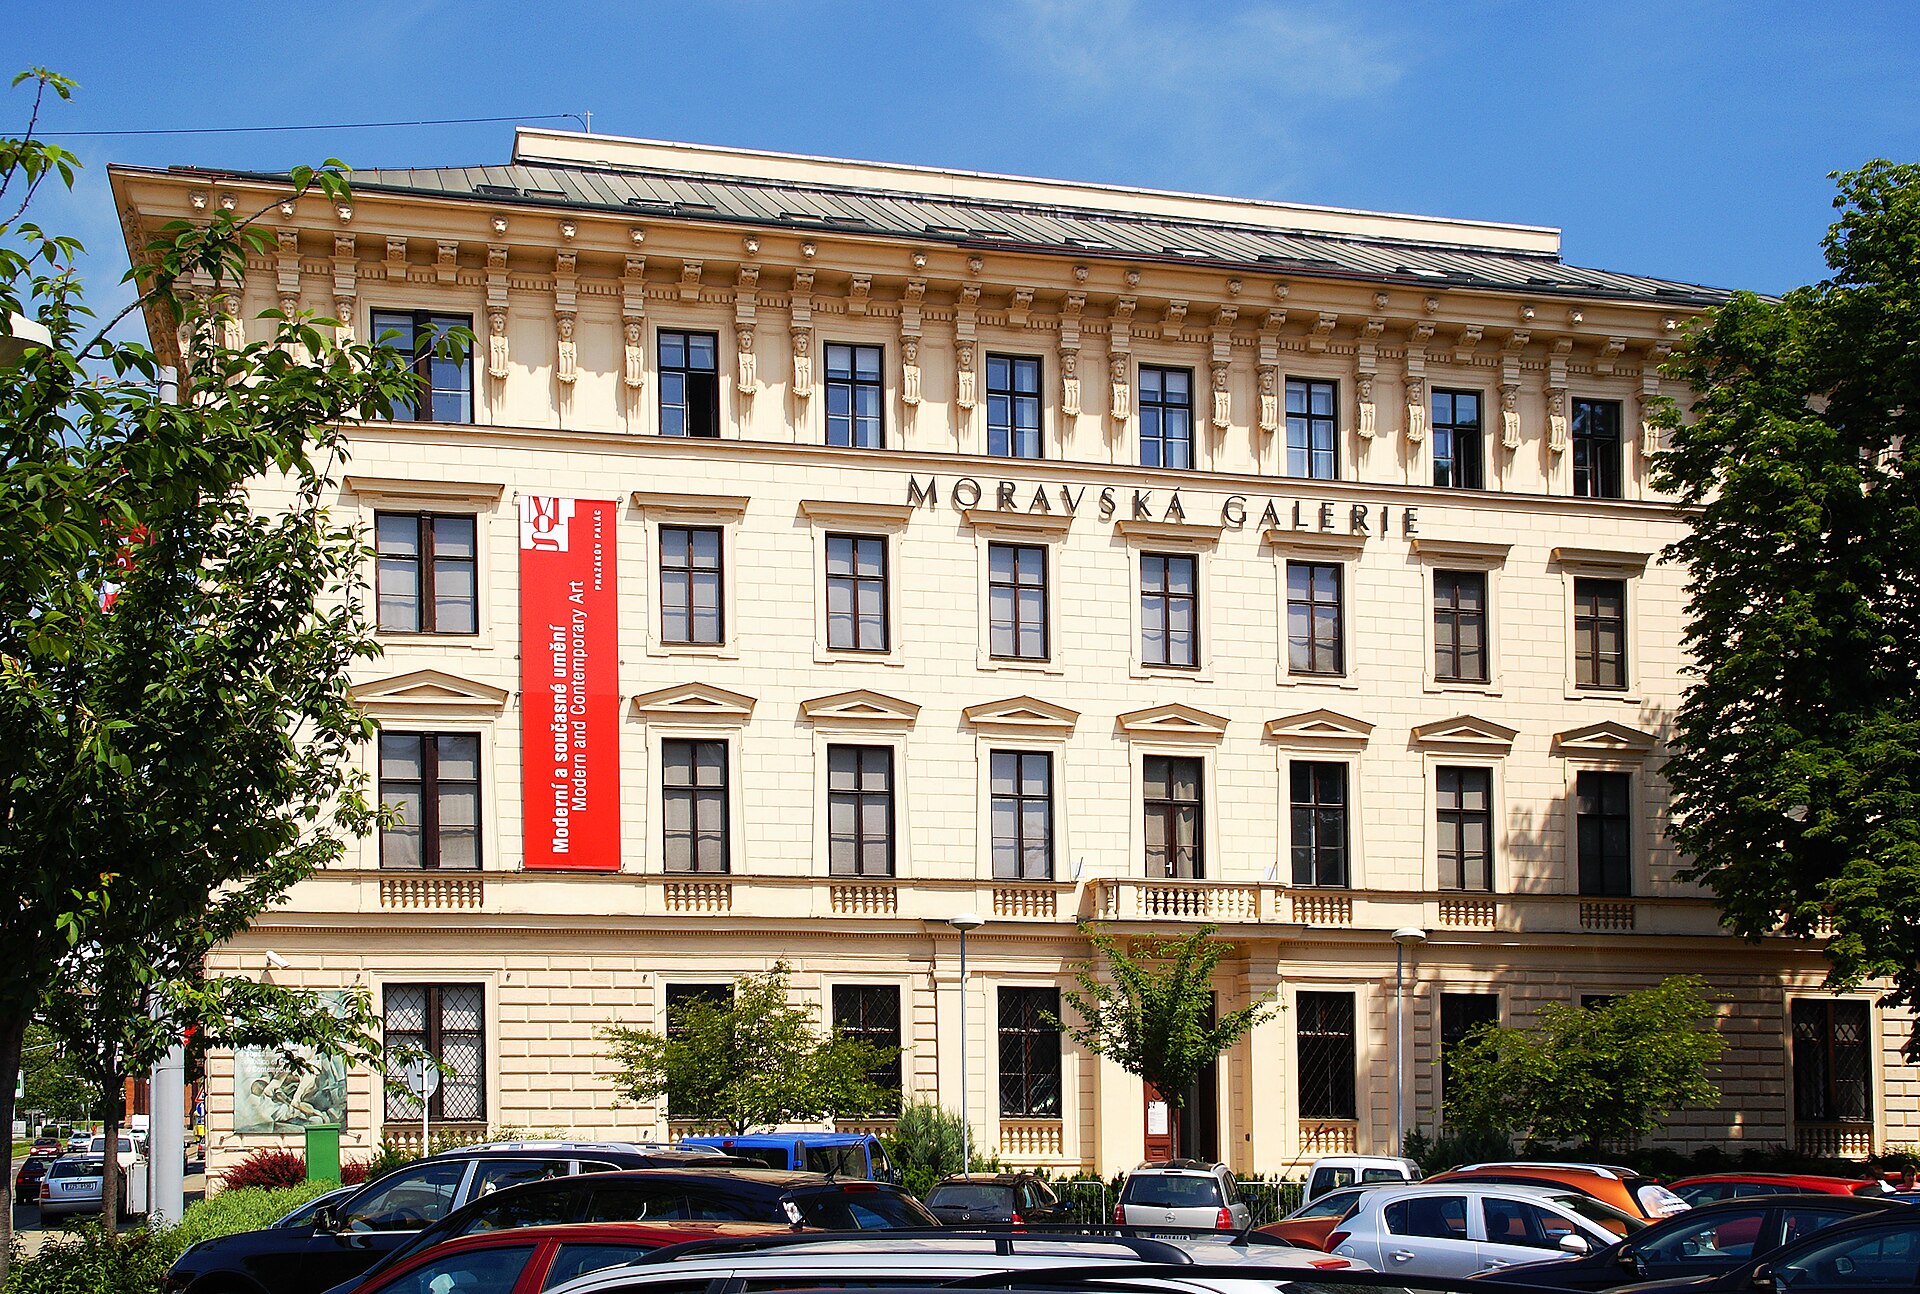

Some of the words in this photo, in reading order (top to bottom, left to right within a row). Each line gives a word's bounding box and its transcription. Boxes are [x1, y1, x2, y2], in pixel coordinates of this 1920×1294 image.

[908, 474, 1185, 520] MORAVSKÁ
[1223, 496, 1419, 534] GALERIE
[568, 580, 584, 604] Art
[548, 624, 567, 678] umění
[569, 608, 589, 715] Contemporary
[549, 683, 568, 763] současné
[570, 720, 587, 749] and
[554, 768, 569, 778] a
[571, 753, 587, 811] Modern
[551, 782, 569, 853] Moderní
